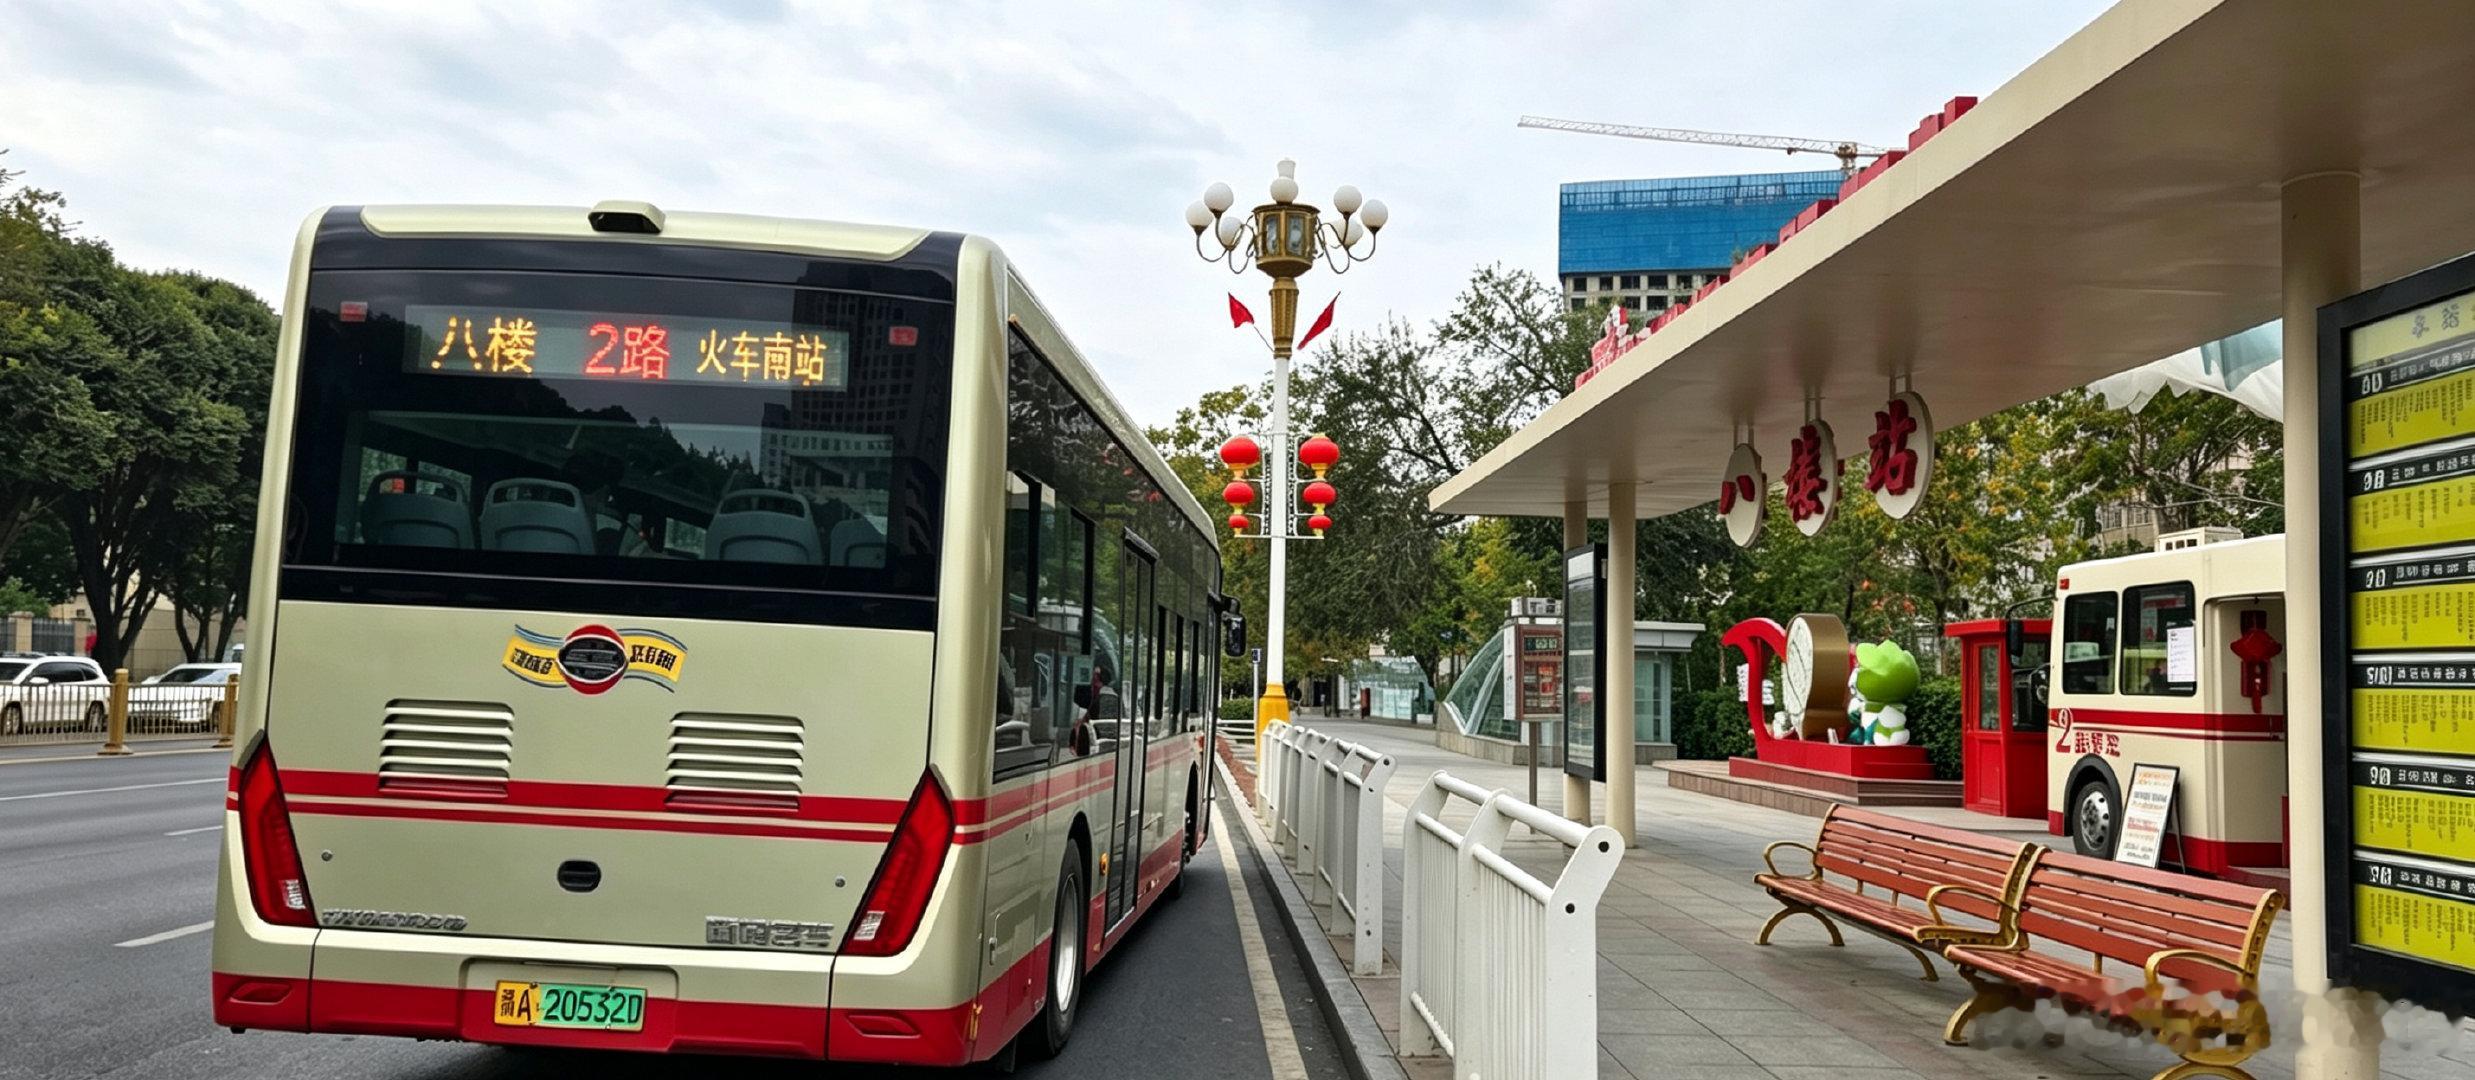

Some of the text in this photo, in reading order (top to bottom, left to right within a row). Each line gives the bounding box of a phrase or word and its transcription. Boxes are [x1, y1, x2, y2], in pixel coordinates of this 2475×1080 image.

[430, 316, 828, 386] 八楼 2路 火车南站
